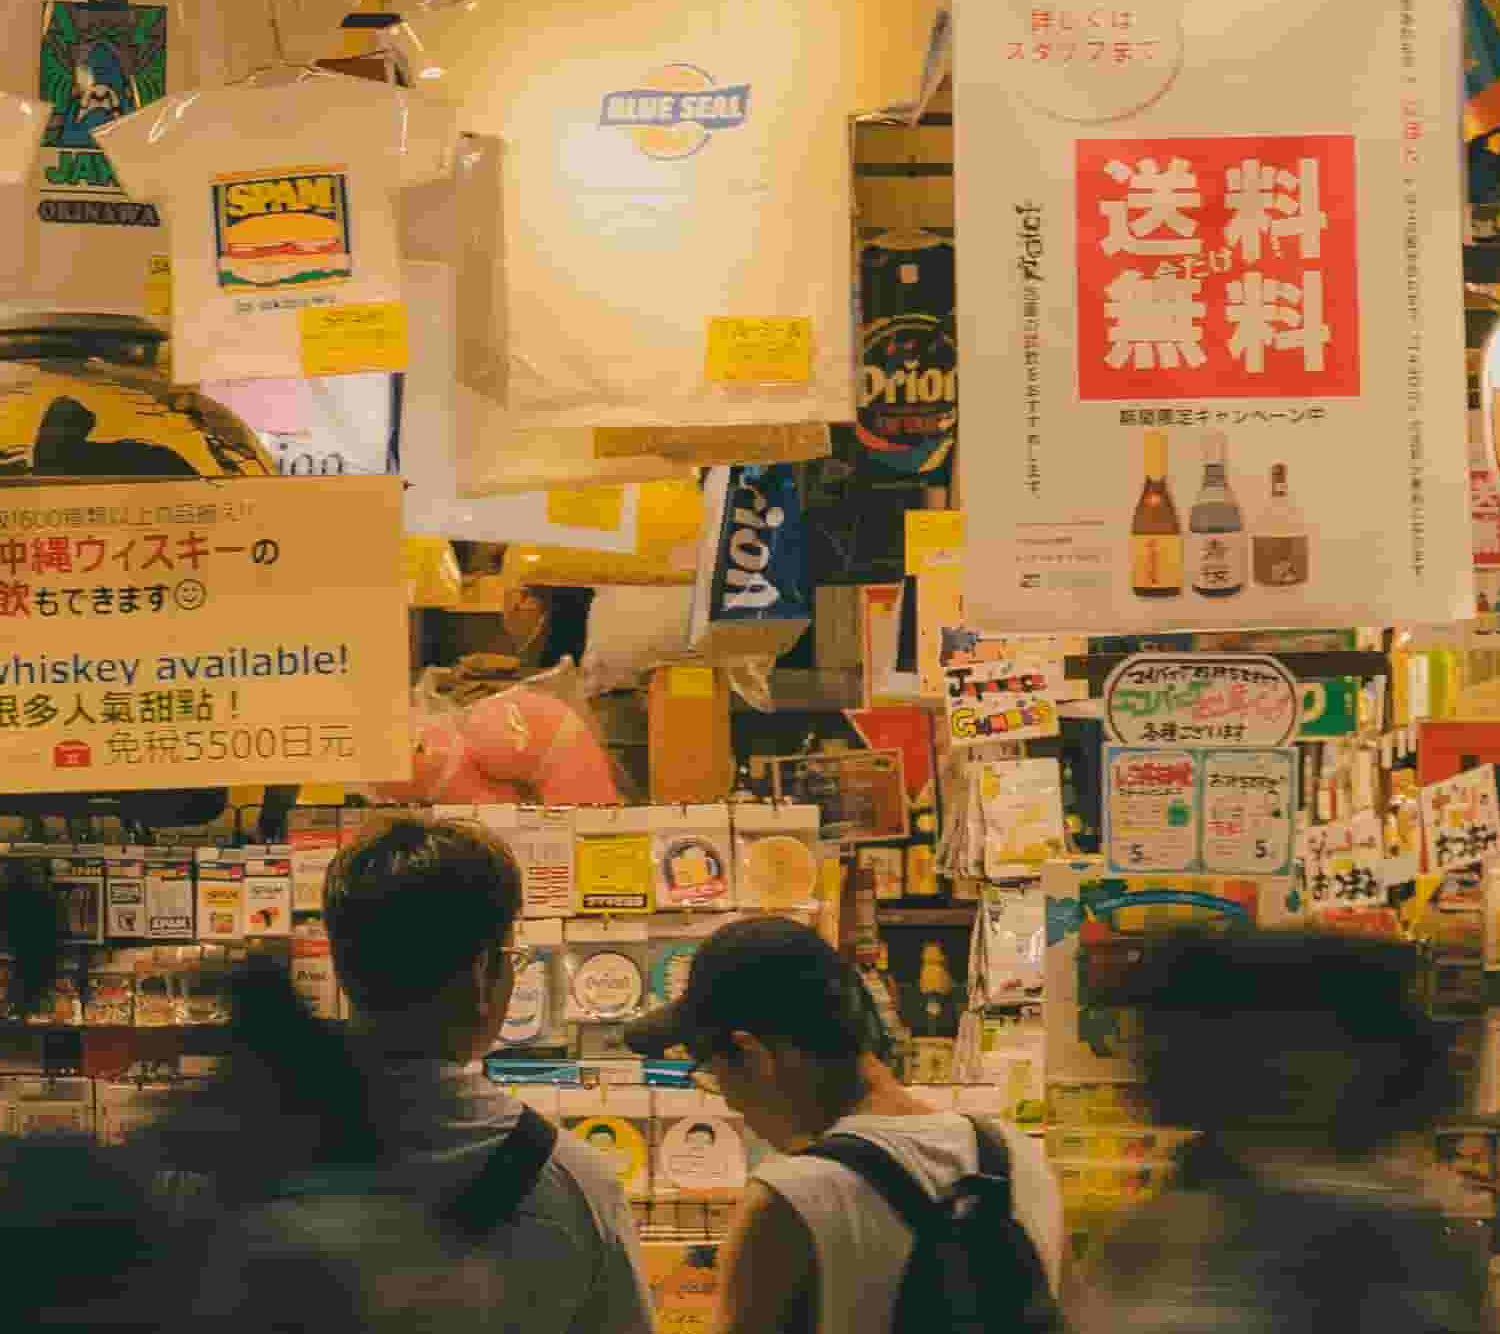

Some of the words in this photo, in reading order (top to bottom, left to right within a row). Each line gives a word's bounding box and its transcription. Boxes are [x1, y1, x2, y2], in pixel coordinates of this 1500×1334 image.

[224, 174, 333, 219] SPAM
[1099, 157, 1329, 265] 送料
[1101, 269, 1332, 374] 無料
[154, 644, 350, 681] available!
